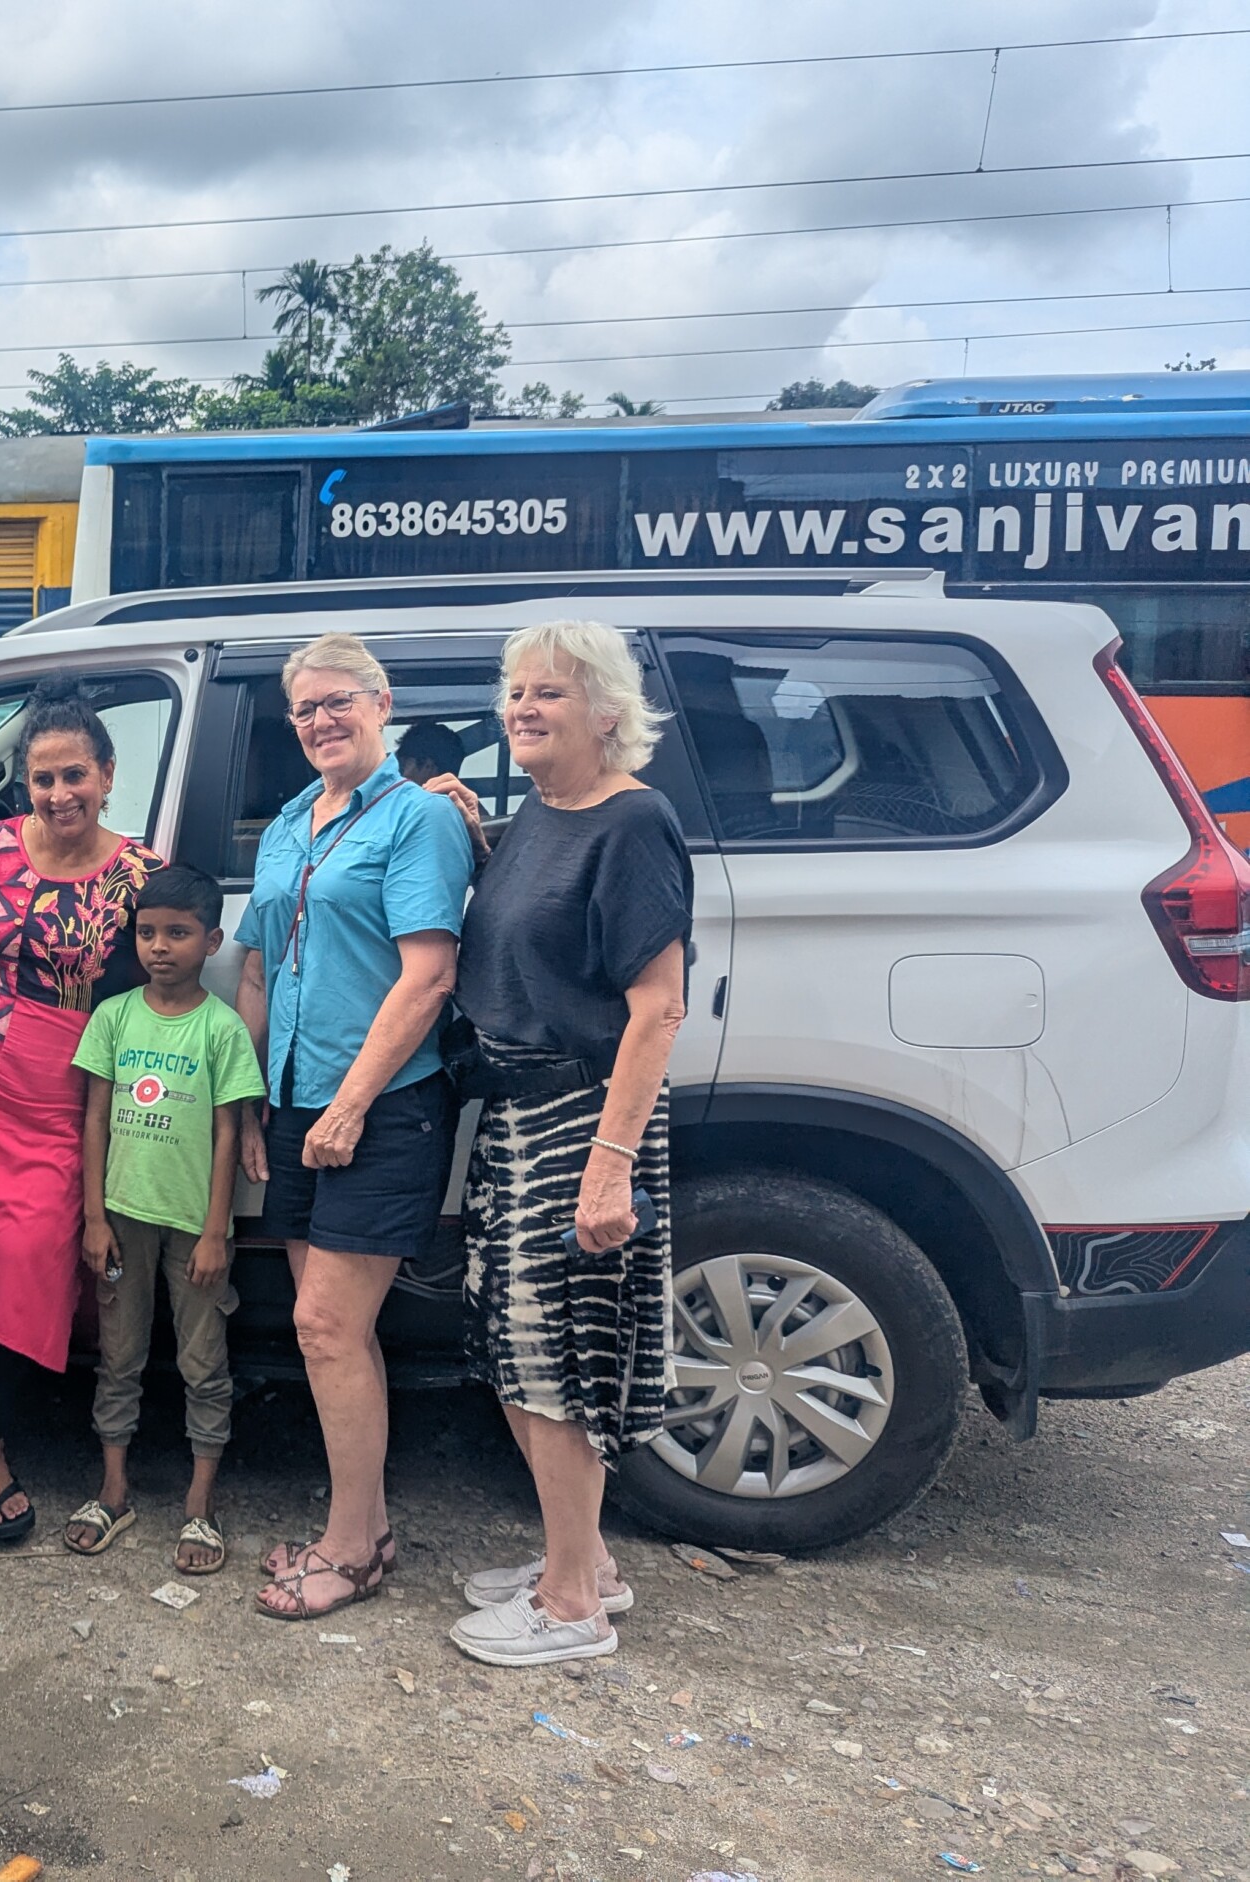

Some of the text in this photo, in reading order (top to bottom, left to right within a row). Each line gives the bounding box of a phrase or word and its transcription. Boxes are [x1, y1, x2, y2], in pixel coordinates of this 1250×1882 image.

[998, 403, 1046, 413] JTAC
[904, 464, 967, 490] 2X2
[988, 461, 1099, 488] LUXURY
[330, 498, 567, 538] 8638645305
[634, 492, 1250, 570] www.sanjivan
[118, 1048, 165, 1070] WATCH
[132, 1129, 151, 1140] YORK
[153, 1133, 179, 1145] WATCH
